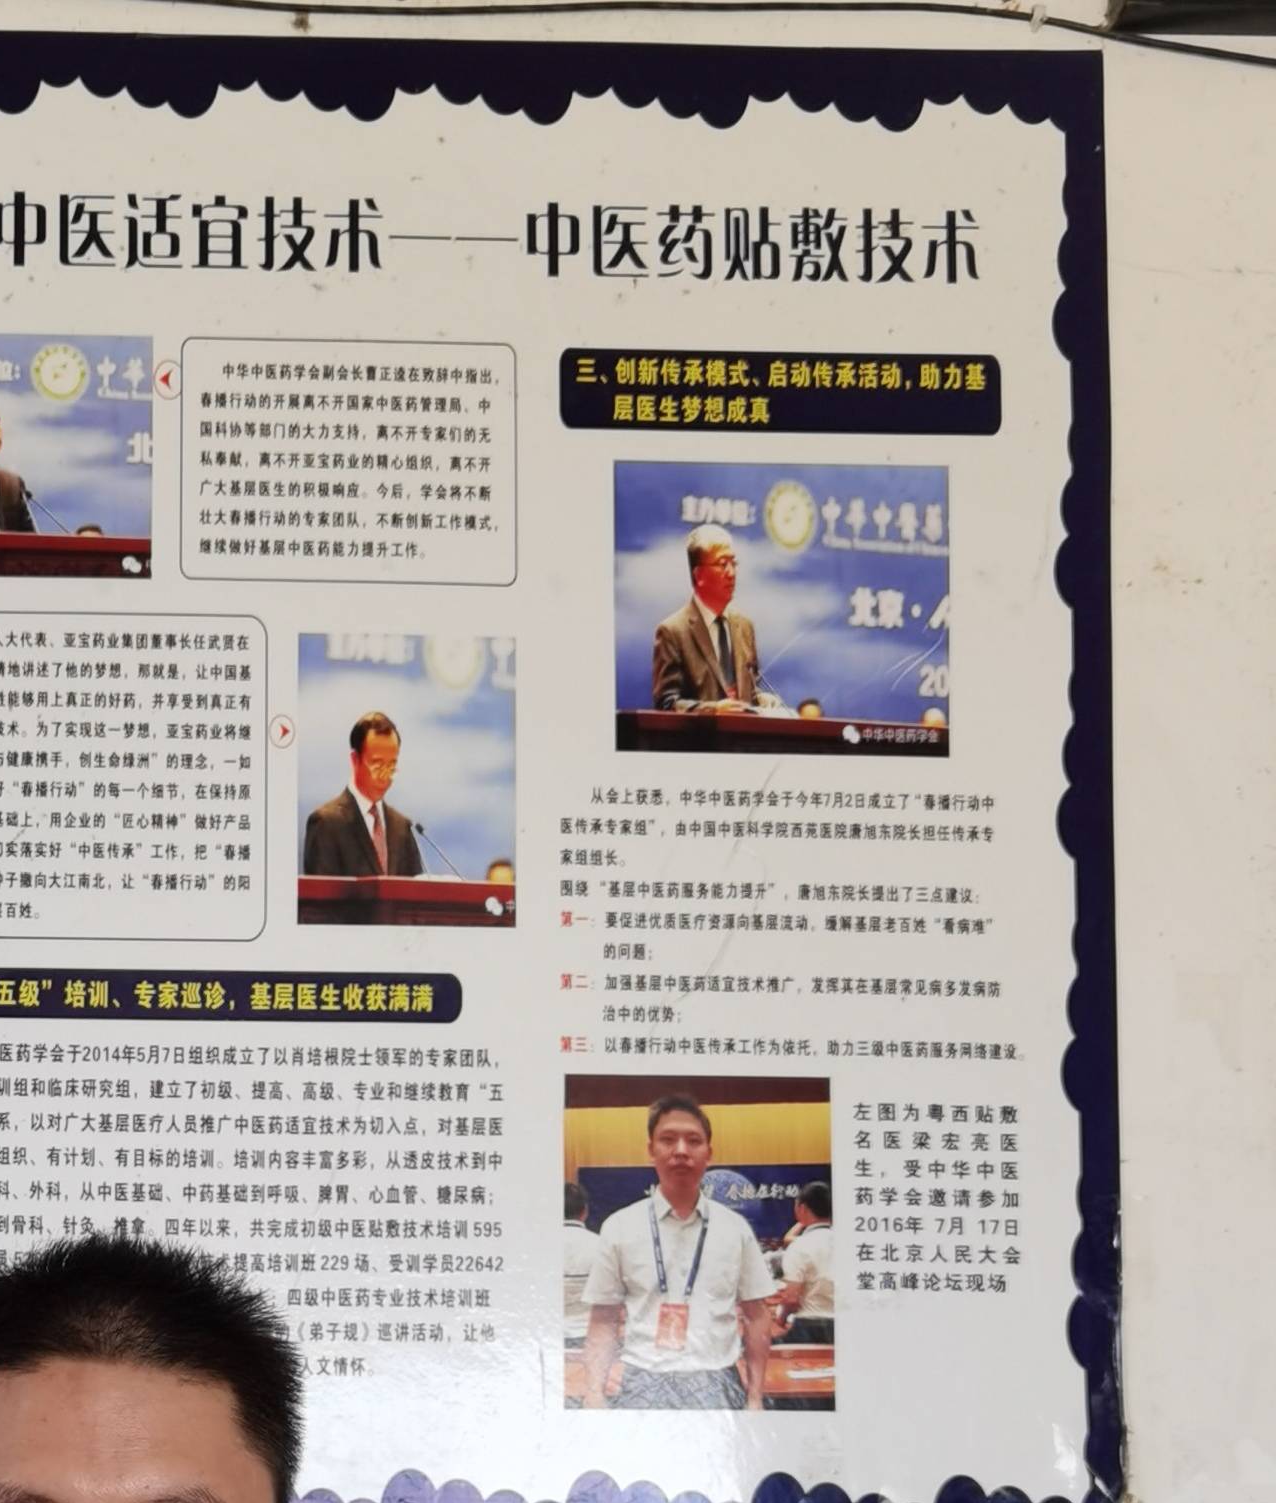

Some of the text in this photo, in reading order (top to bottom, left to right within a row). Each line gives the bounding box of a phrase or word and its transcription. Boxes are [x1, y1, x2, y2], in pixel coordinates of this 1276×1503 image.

[575, 358, 985, 391] 三、创新传承模式、启动传承活动，助力基
[612, 395, 770, 425] 层医生梦想成真
[560, 849, 625, 867] 家组组长。
[853, 1103, 1019, 1124] 左图为粤西贴敷
[854, 1130, 1018, 1152] 名医梁宏亮医
[854, 1158, 1019, 1180] 生，受中华中医
[854, 1187, 1019, 1208] 药学会邀请参加
[856, 1243, 1021, 1265] 在北京人民大会
[857, 1271, 1007, 1293] 堂高峰论坛现场
[287, 1288, 491, 1308] 四级中医药专业技术培训班
